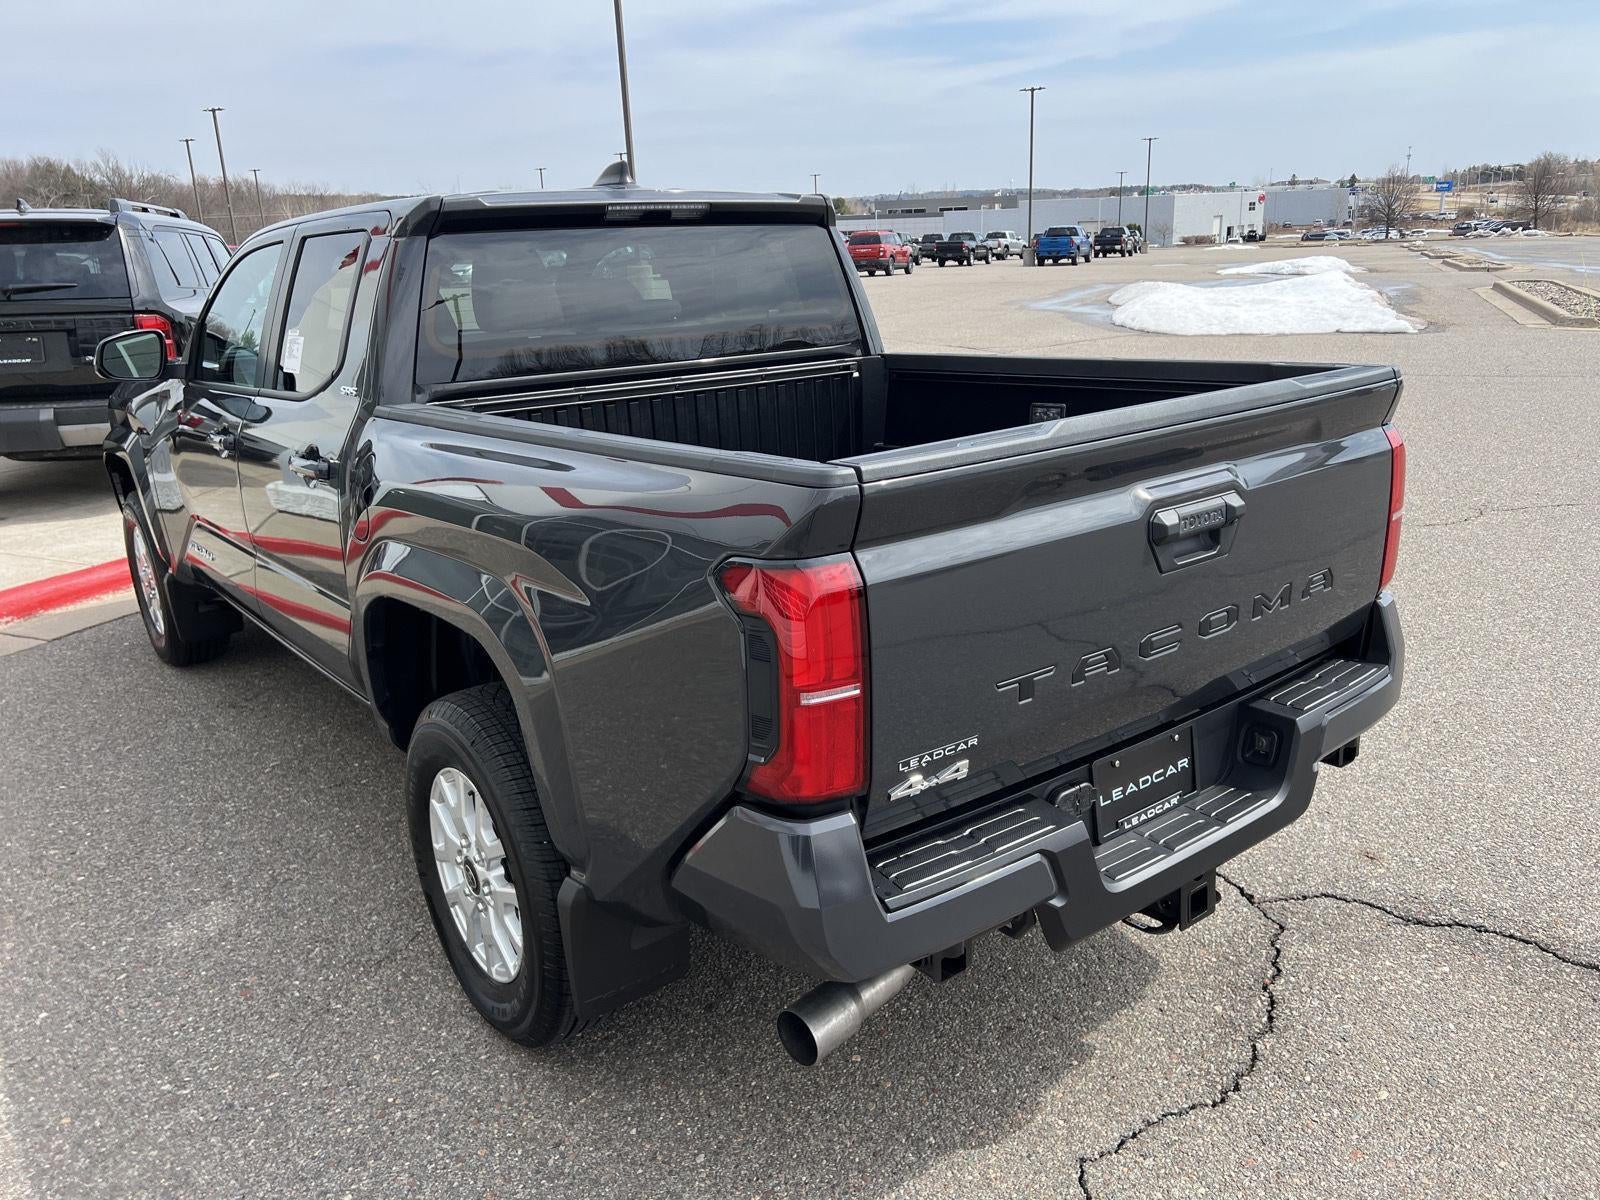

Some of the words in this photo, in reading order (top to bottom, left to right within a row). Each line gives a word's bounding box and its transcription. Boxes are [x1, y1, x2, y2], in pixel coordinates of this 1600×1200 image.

[1182, 508, 1224, 531] TOYOTA
[995, 567, 1334, 704] TACOMA
[899, 738, 978, 772] LEADCAR
[1099, 757, 1189, 807] LEADCAR
[1124, 796, 1180, 829] LEADCAR
